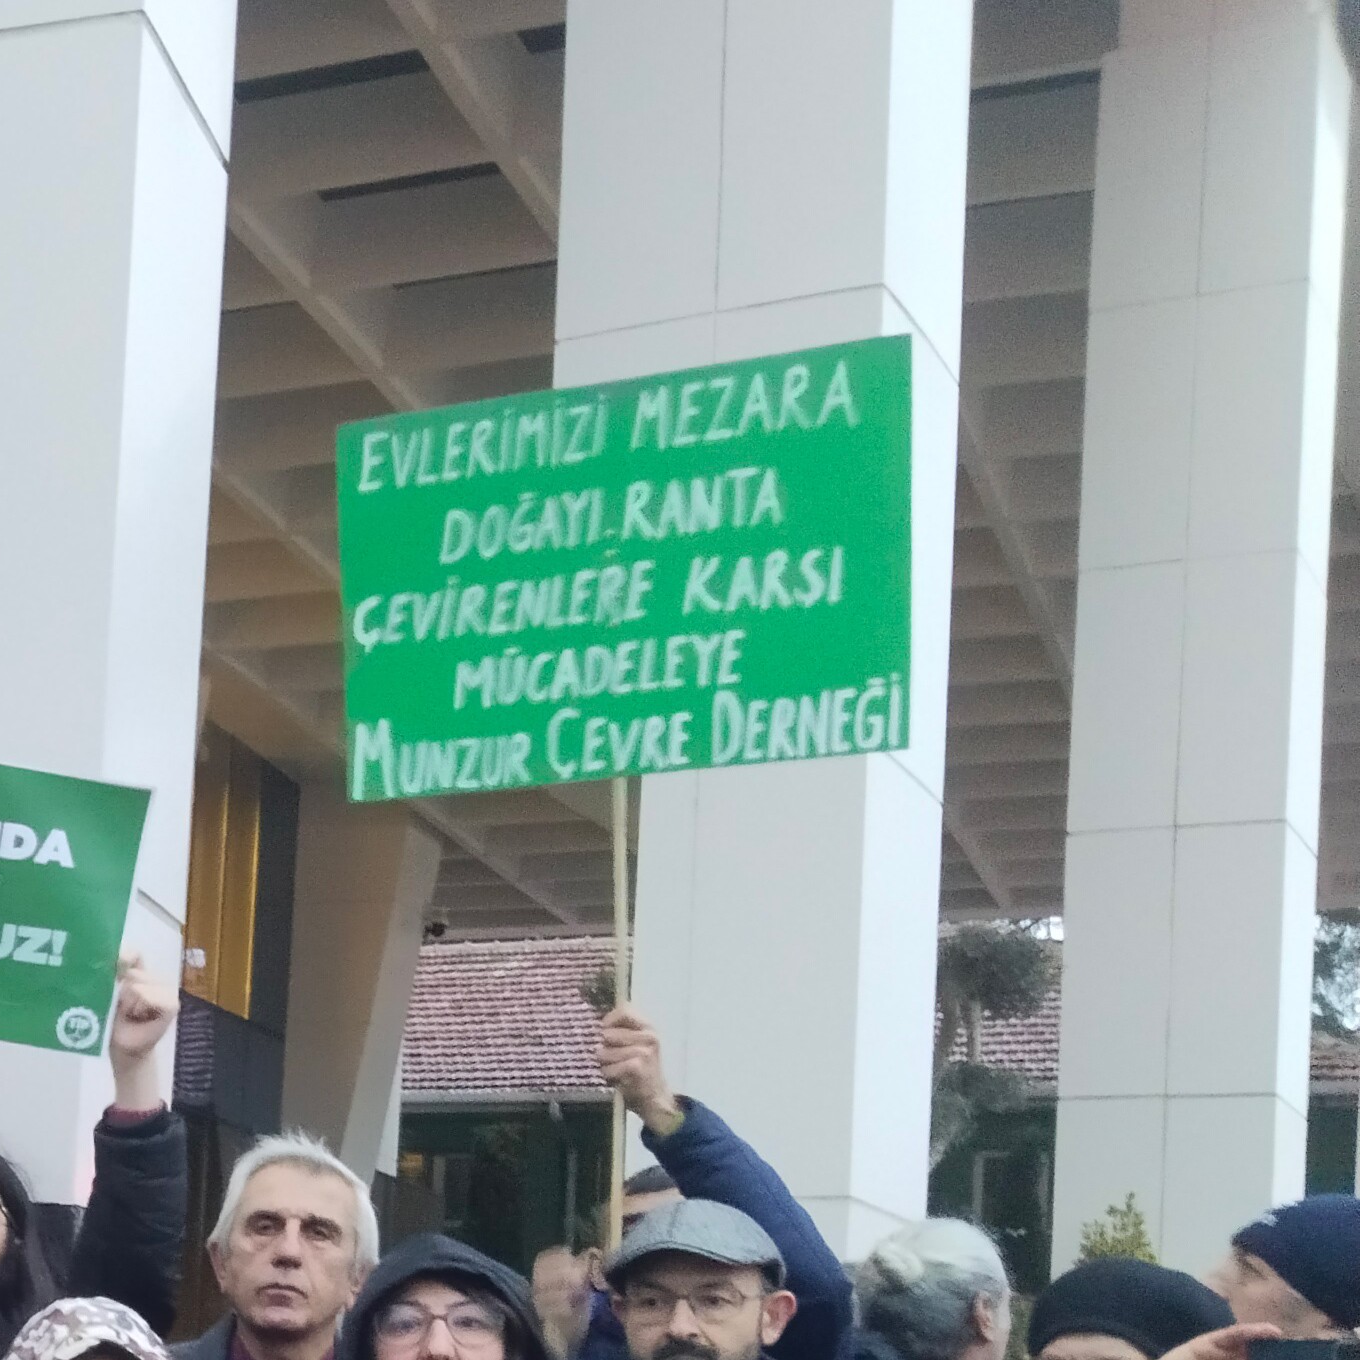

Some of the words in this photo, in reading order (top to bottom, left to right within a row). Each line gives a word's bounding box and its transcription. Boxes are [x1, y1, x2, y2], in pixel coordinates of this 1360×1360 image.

[629, 360, 860, 453] MEZARA
[620, 464, 784, 542] RANTA
[351, 559, 656, 653] ÇEVİRENLERE
[453, 629, 748, 710] MÜCADELEYE
[350, 717, 534, 801] MUNZUR
